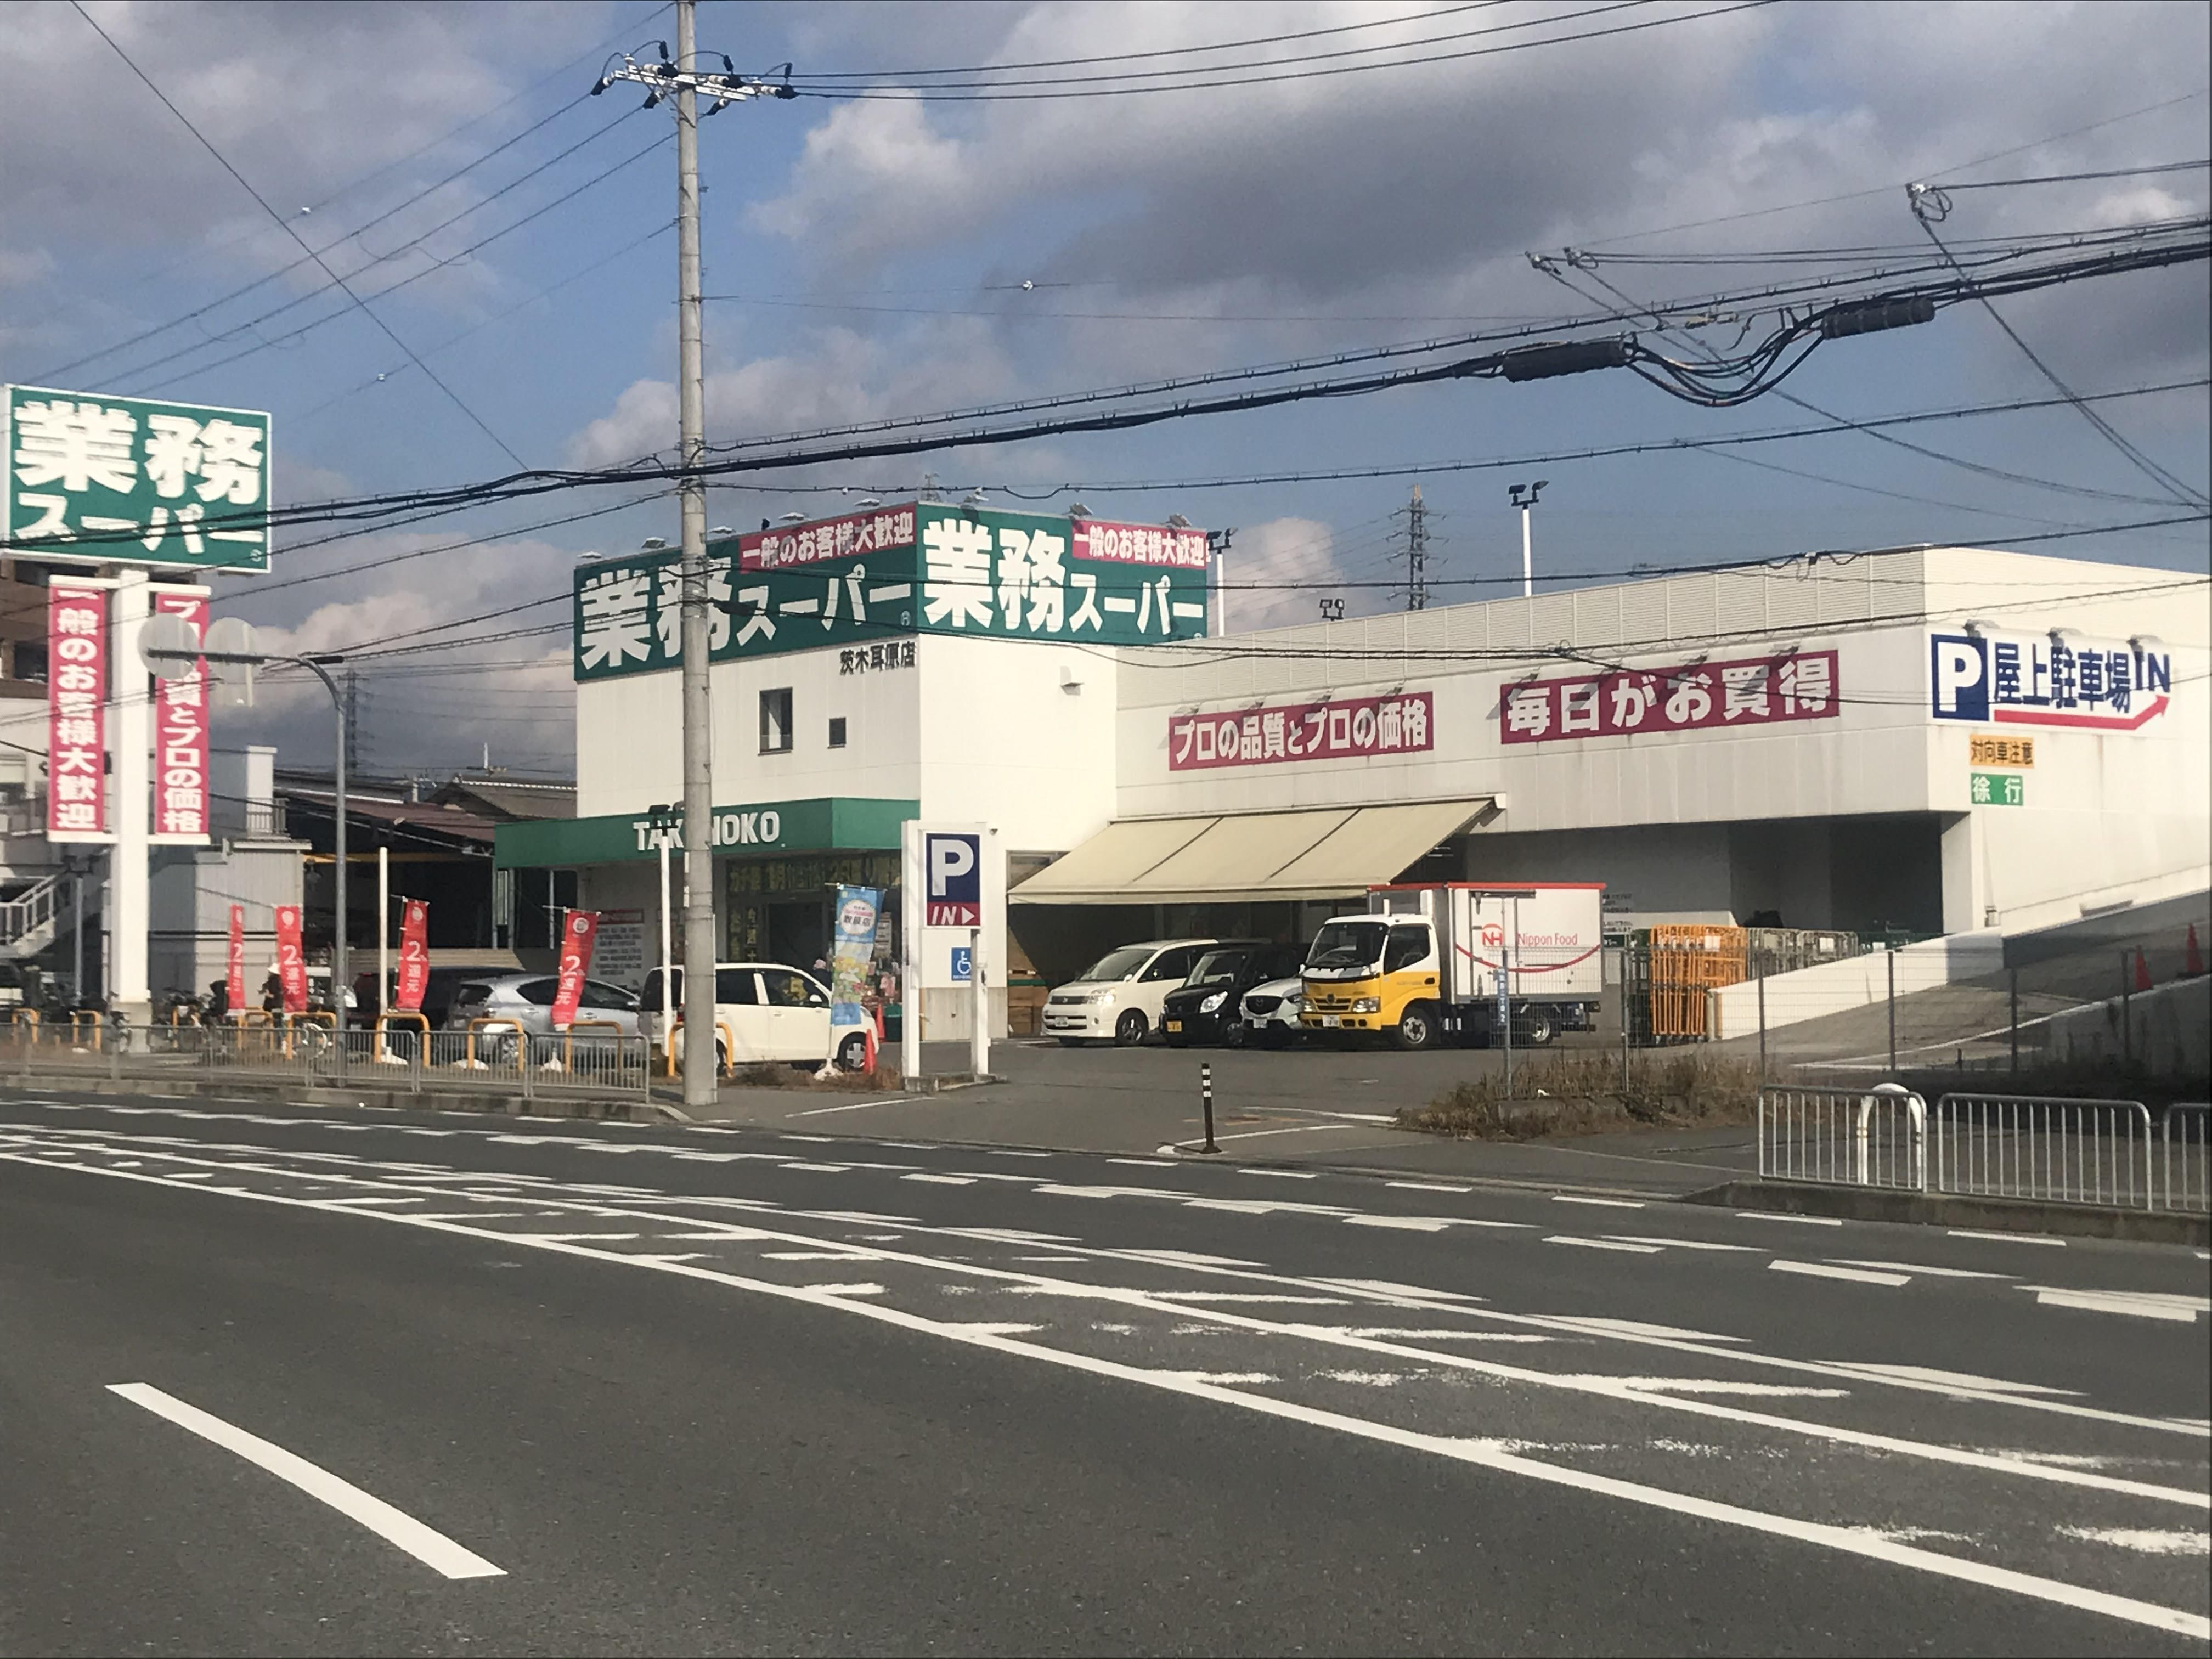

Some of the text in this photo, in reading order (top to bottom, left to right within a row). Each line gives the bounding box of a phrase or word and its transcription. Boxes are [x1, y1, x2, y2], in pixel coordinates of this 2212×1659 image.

[14, 400, 263, 505] 業務
[14, 492, 264, 554] スーパー
[743, 512, 913, 567] 一般のお客様大歓迎
[1074, 524, 1205, 567] 一般のお客様大歓迎
[923, 518, 1203, 635] 業務スーパー
[840, 641, 915, 675] 茨木耳原店
[57, 589, 99, 830] 一般のお客様大歓迎
[1508, 657, 1831, 736] 毎日がお買得
[1174, 699, 1427, 764] プロの品質とプロの価格
[1971, 740, 2033, 766] 対向車注意
[931, 839, 974, 896] P
[931, 906, 957, 925] IN
[1517, 933, 1578, 946] Nippon Food
